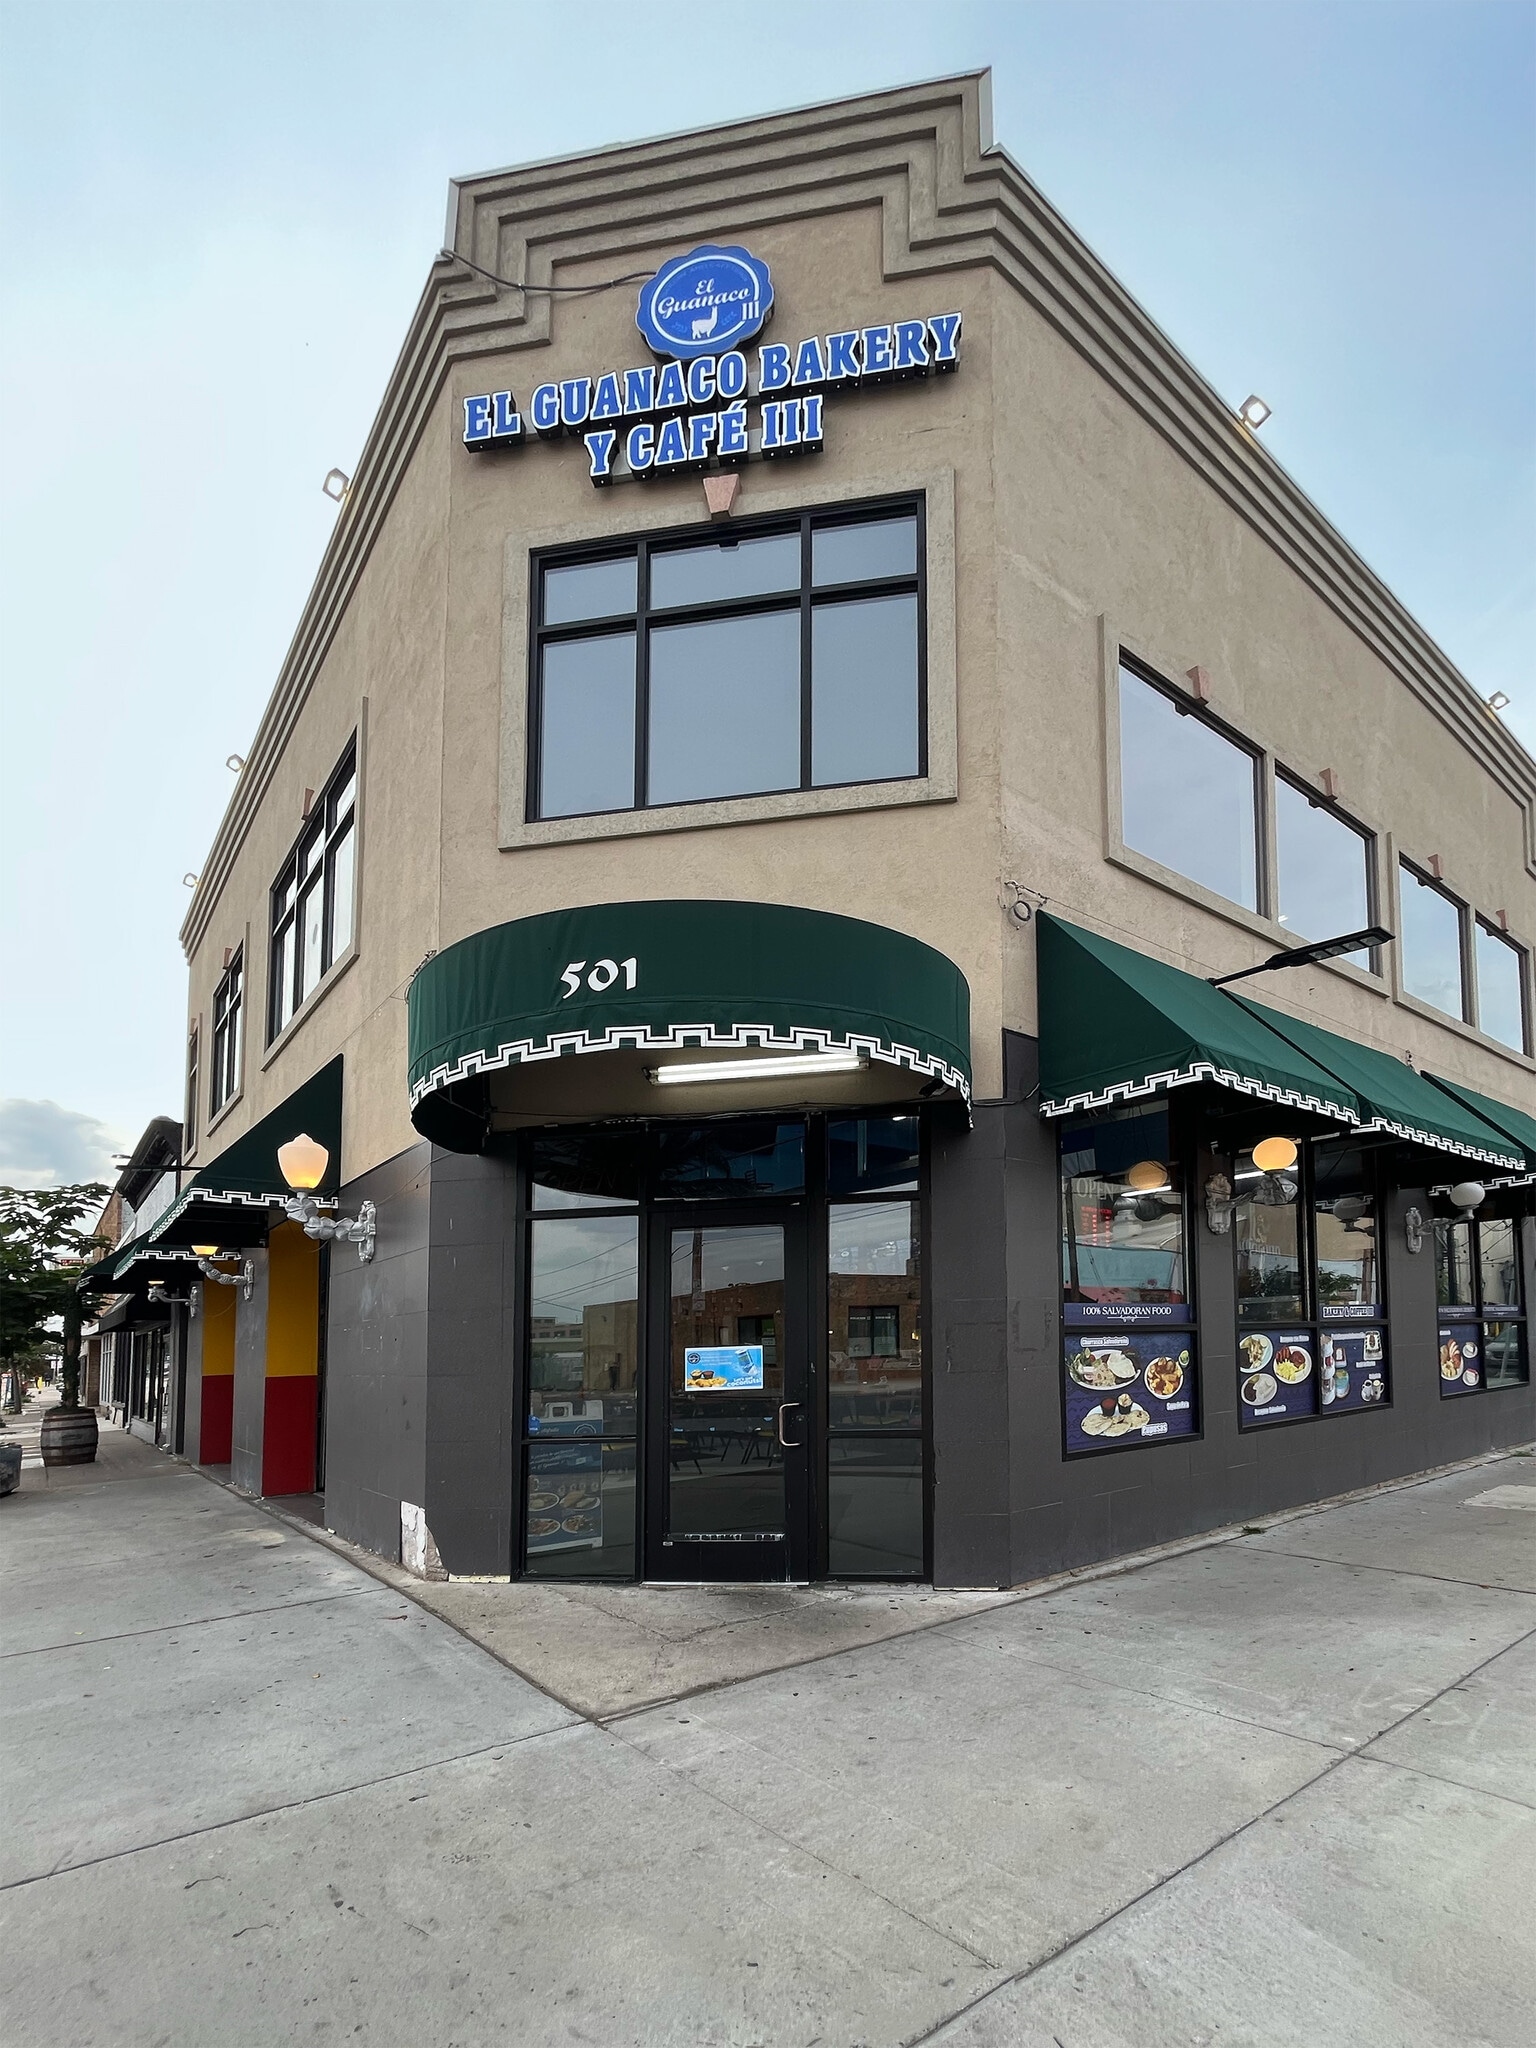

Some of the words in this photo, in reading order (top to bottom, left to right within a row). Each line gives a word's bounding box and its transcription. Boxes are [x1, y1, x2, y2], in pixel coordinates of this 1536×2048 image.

[695, 278, 715, 296] El
[657, 287, 750, 320] Guanaco
[742, 300, 760, 321] III
[463, 390, 521, 443] EL
[530, 350, 747, 430] GUANACO
[758, 311, 962, 393] BAKERY
[584, 429, 617, 477] Y
[626, 399, 749, 471] CAFÉ
[760, 394, 824, 449] III
[560, 957, 637, 999] 501
[1076, 1179, 1115, 1201] OPEN
[1082, 1306, 1101, 1316] 100%
[1101, 1306, 1152, 1316] SALVADORAN
[1151, 1306, 1172, 1316] FOOD
